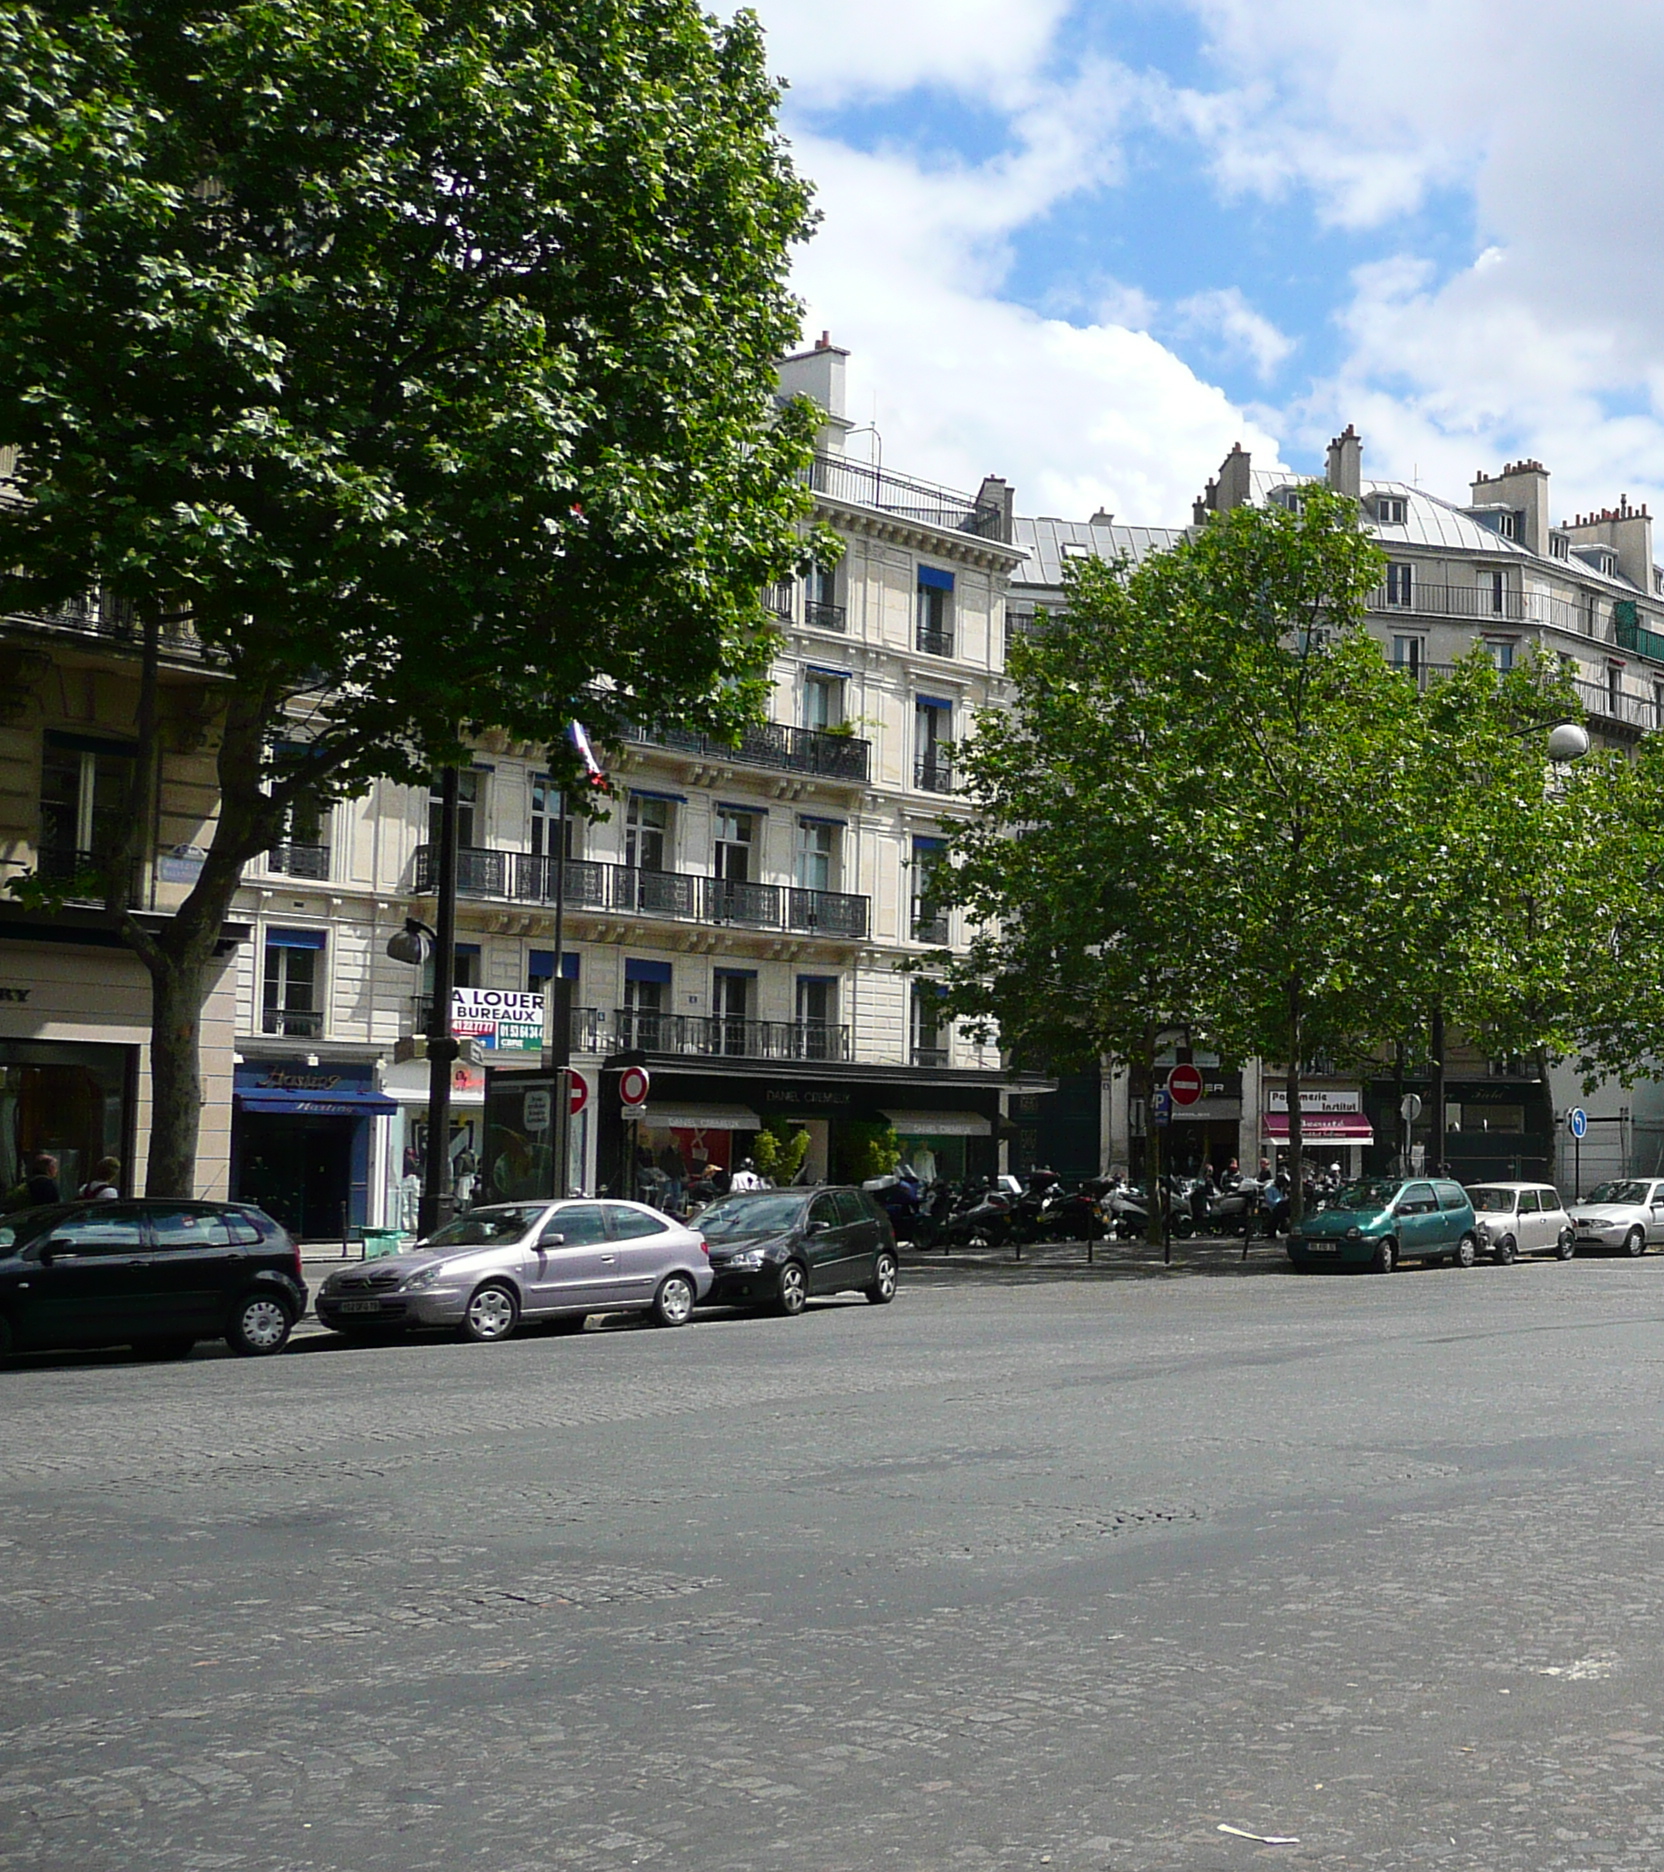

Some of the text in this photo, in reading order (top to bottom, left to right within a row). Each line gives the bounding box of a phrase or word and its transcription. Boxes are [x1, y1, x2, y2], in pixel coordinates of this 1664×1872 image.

[452, 990, 544, 1009] A LOUER
[457, 1006, 535, 1022] BUREAUX
[500, 1025, 508, 1036] 01
[766, 1090, 800, 1102] DANIEL
[1322, 1102, 1356, 1111] Institut
